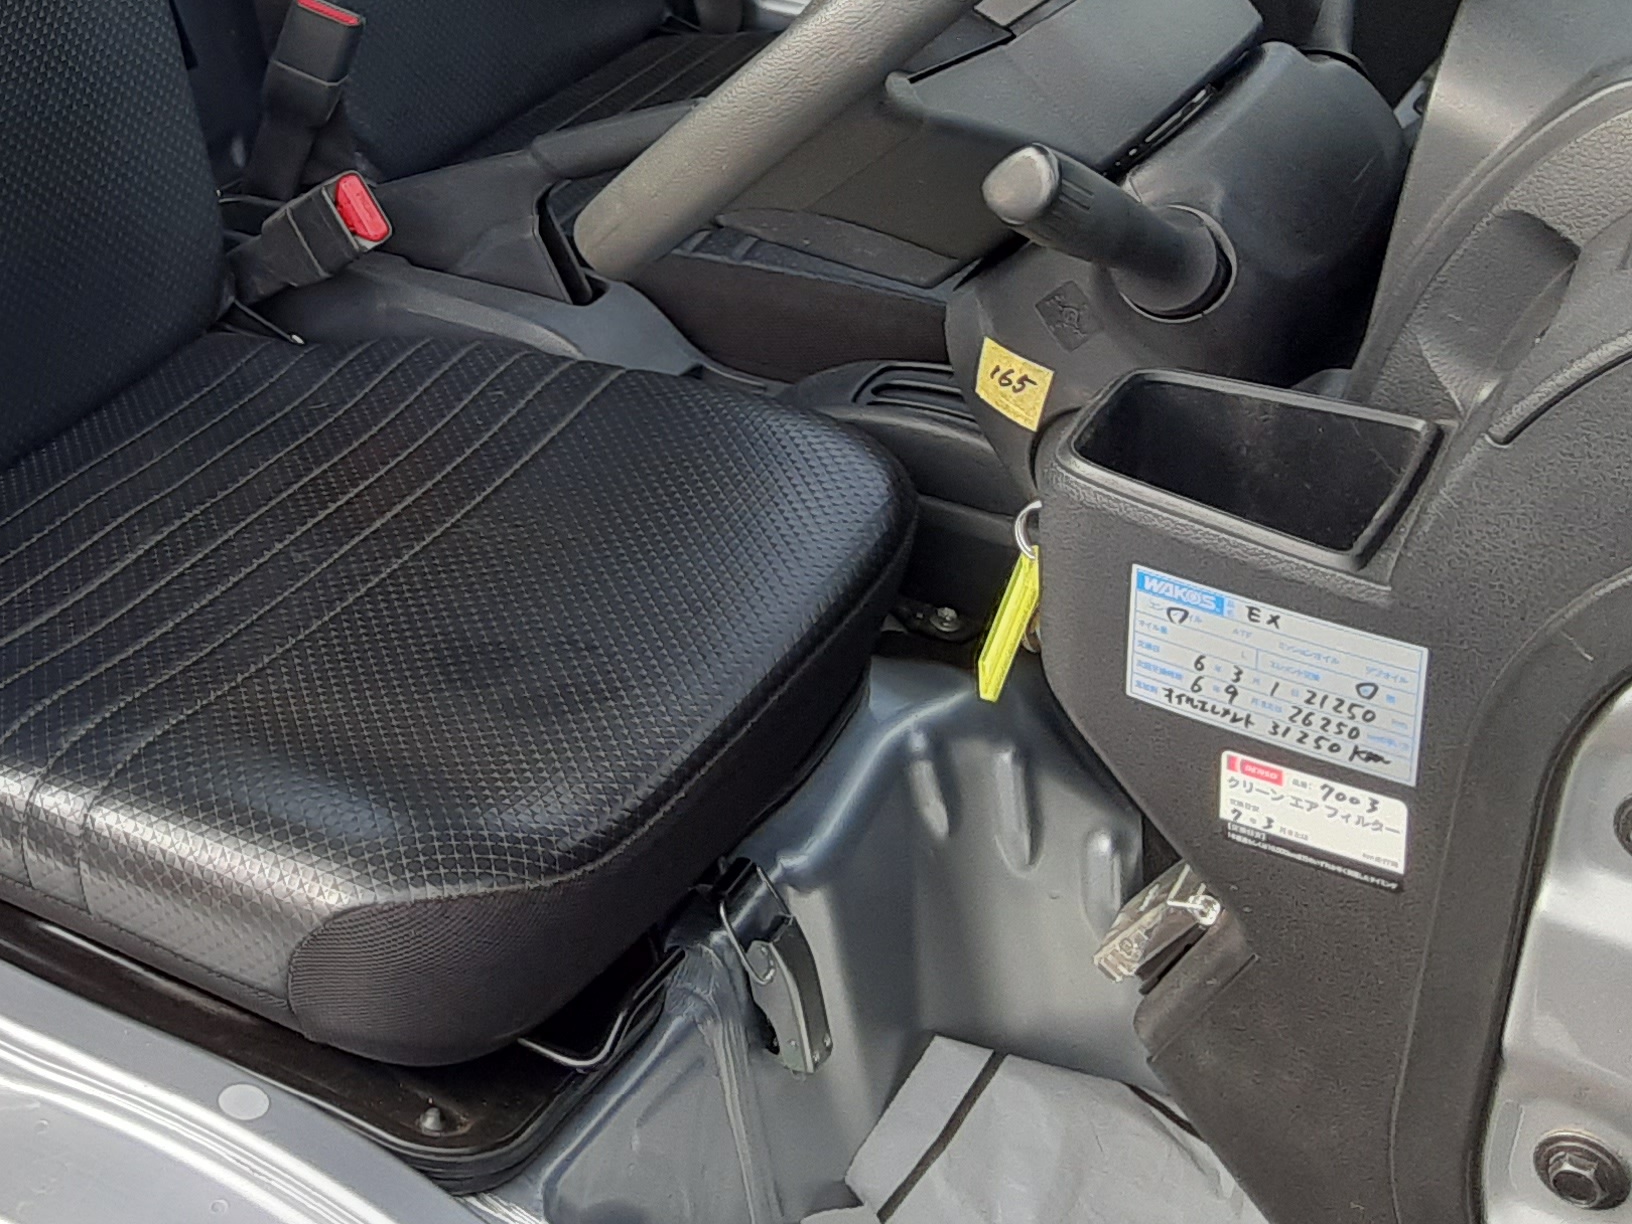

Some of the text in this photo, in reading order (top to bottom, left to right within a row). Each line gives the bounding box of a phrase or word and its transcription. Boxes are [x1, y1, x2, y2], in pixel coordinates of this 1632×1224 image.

[989, 364, 1037, 394] 165
[1194, 654, 1206, 672] 6
[1231, 664, 1244, 683] 3
[1304, 689, 1376, 723] 21250
[1190, 676, 1205, 693] 6
[1224, 684, 1239, 705] 9
[1288, 705, 1360, 740] 26250
[1268, 720, 1342, 753] 31250
[1320, 782, 1381, 814] 7003
